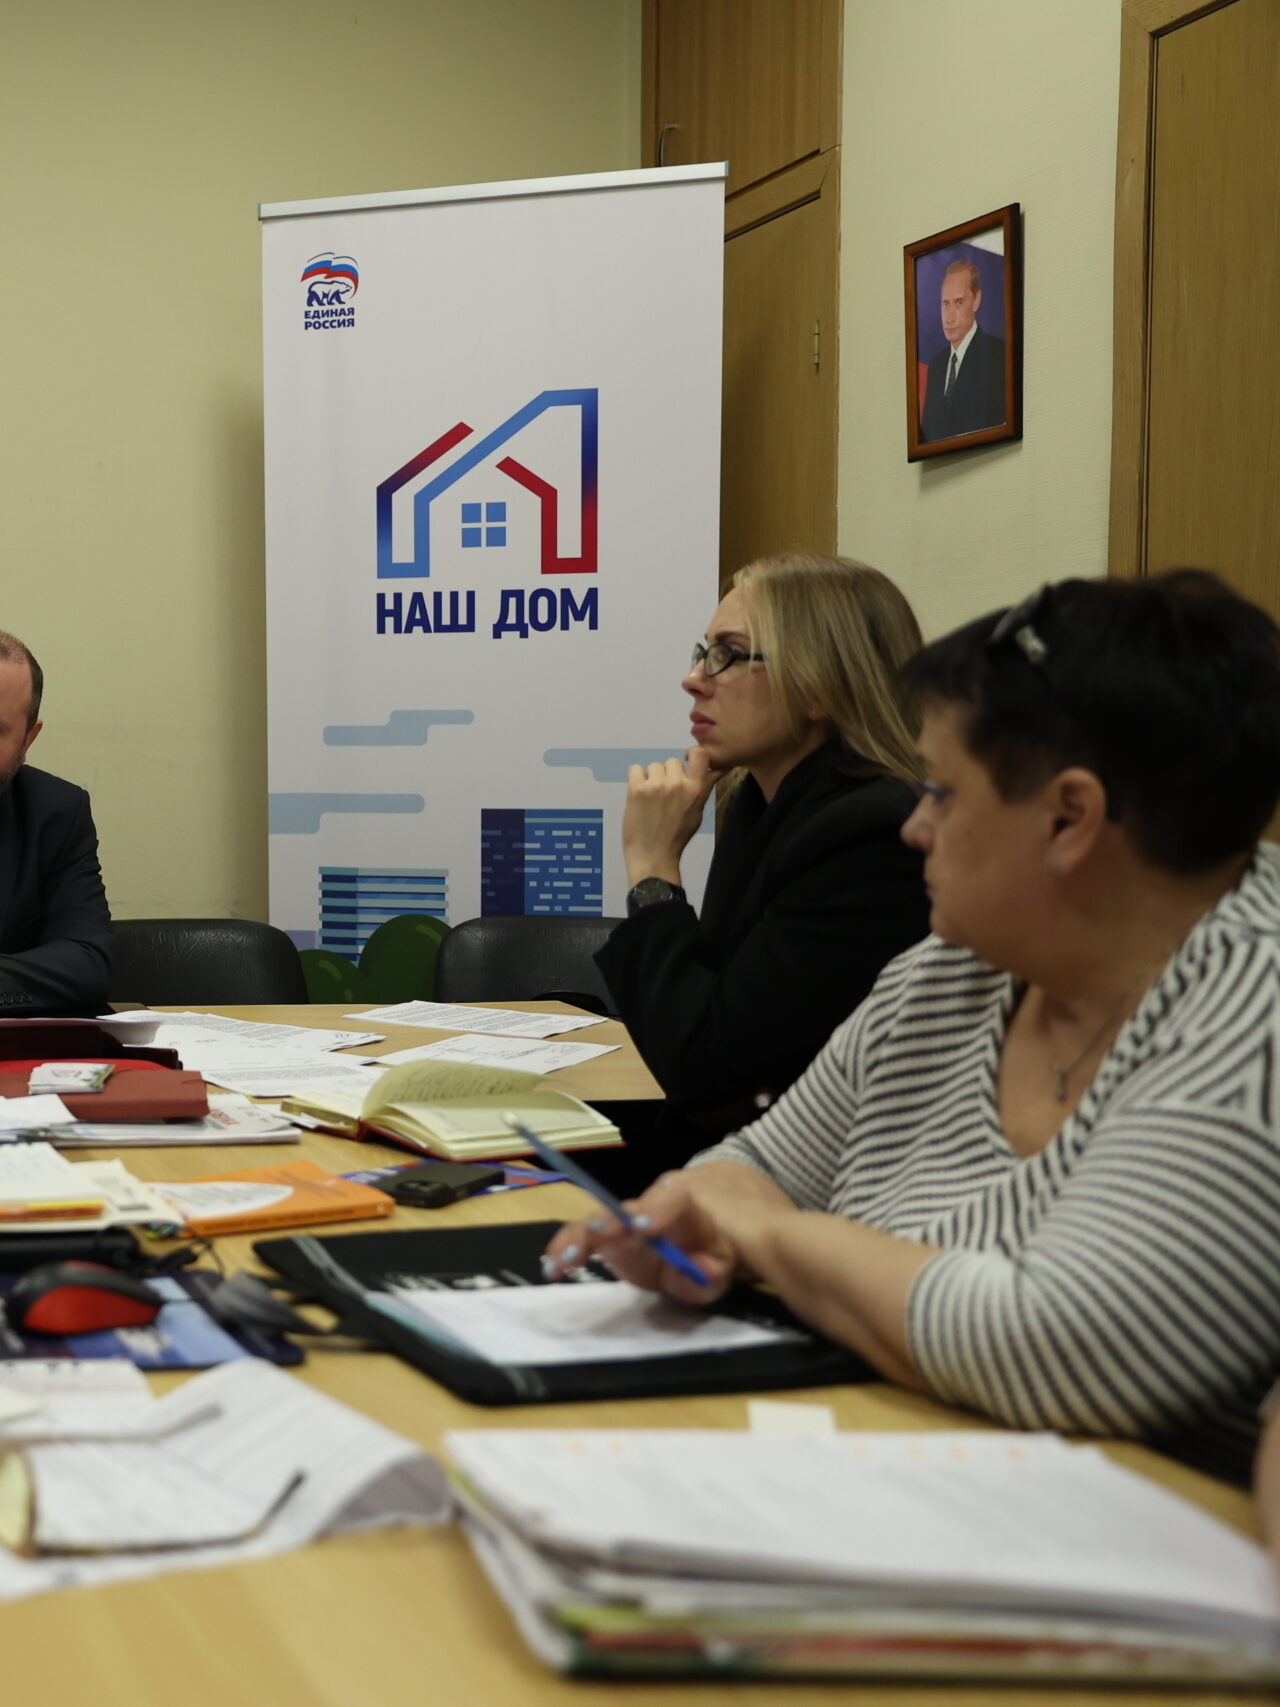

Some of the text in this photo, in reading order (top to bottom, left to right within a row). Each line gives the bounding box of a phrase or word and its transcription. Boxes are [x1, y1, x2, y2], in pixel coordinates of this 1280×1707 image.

[304, 307, 355, 320] ЕДИНАЯ
[304, 318, 355, 331] РОССИЯ
[376, 587, 599, 640] НАШ ДОМ
